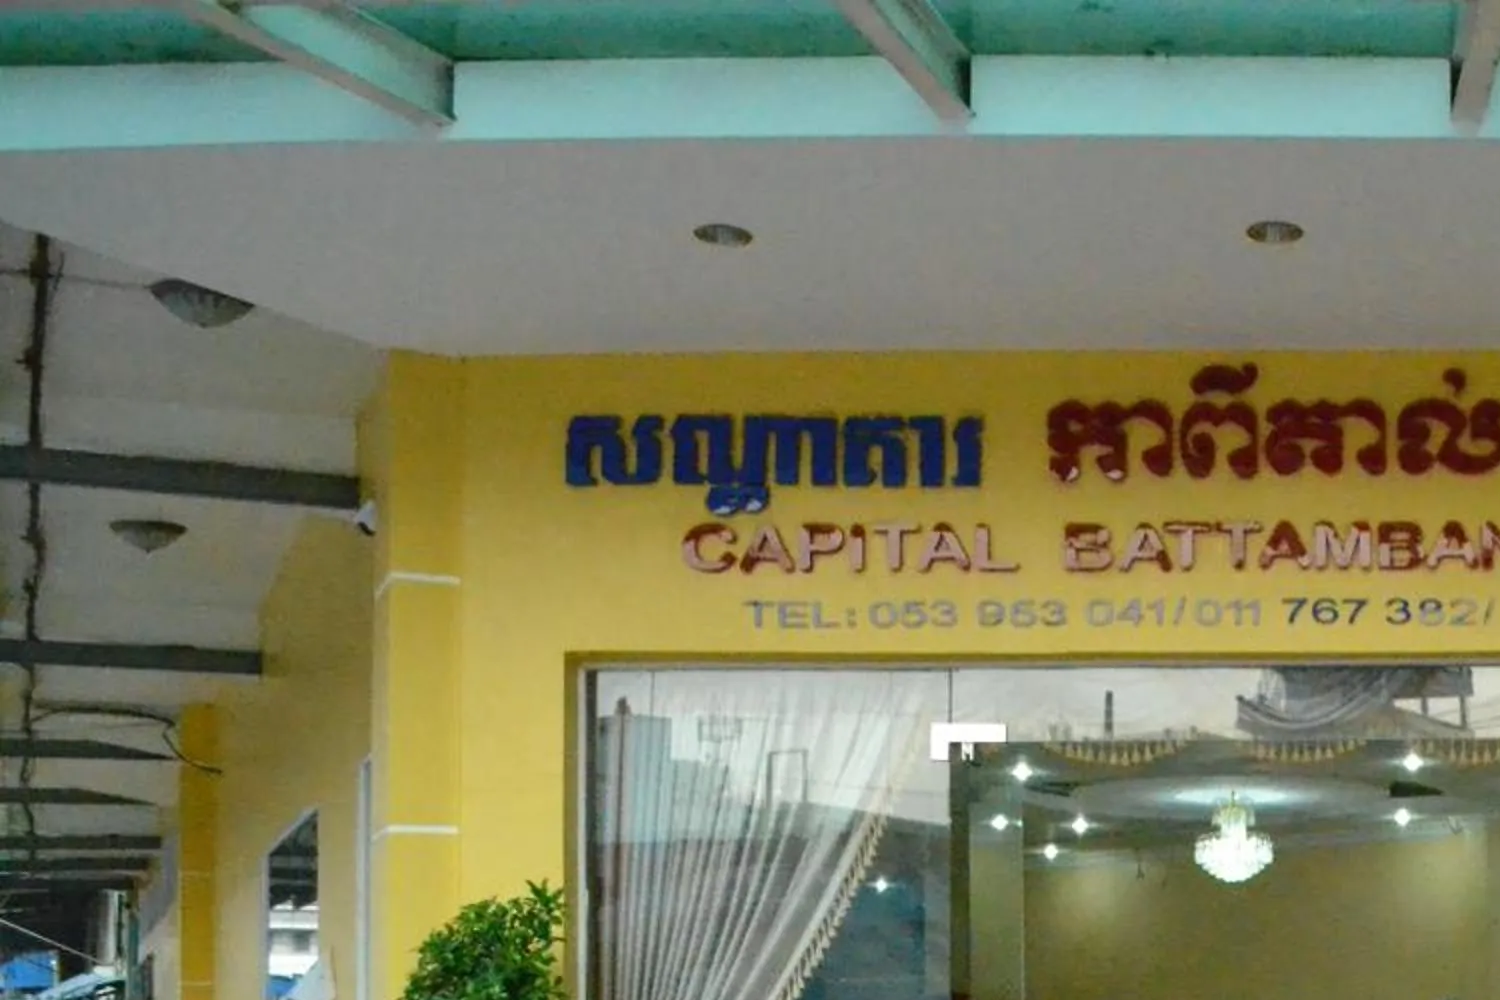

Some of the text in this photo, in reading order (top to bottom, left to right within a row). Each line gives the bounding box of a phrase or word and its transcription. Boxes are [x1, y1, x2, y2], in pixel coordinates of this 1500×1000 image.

[683, 522, 1020, 575] CAPITAL
[977, 600, 1067, 630] 953
[1285, 598, 1367, 625] 767
